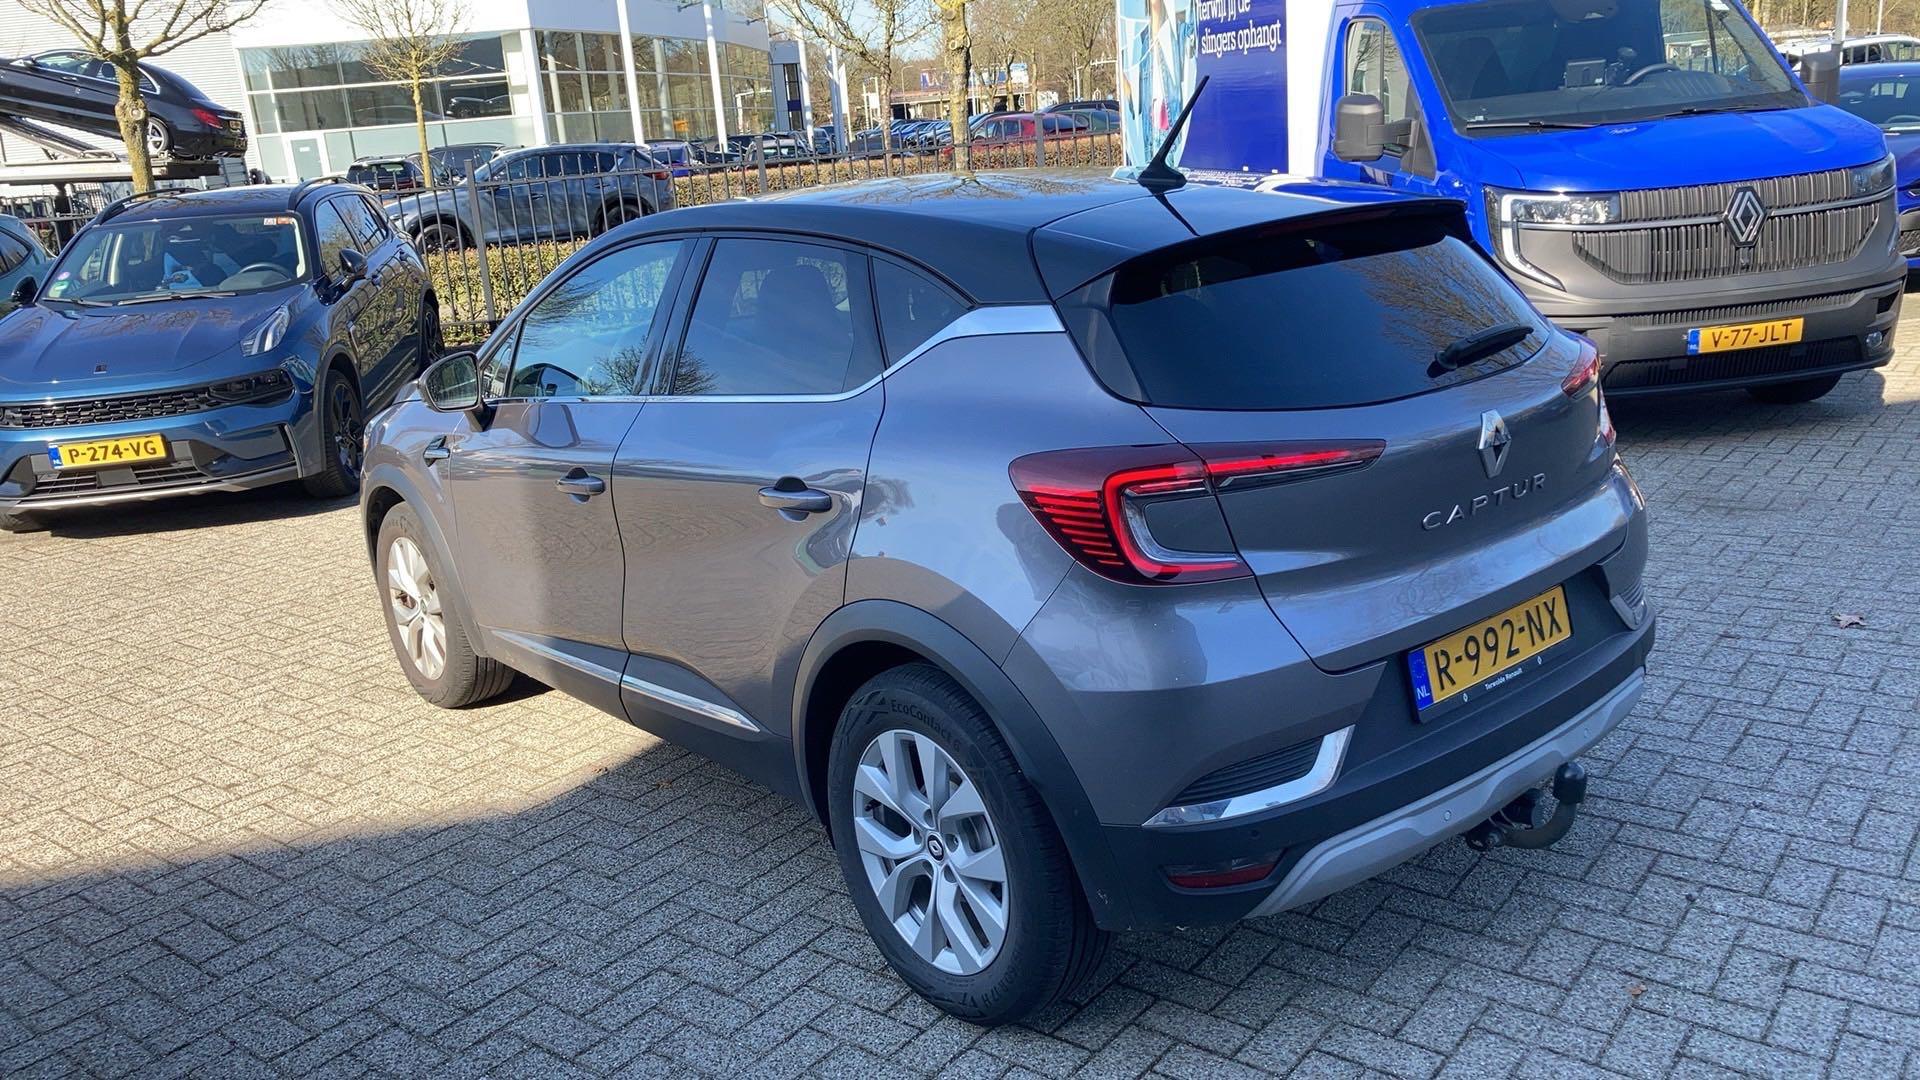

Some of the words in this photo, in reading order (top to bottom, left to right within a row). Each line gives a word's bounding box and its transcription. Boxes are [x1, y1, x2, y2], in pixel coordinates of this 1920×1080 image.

[1198, 0, 1226, 23] terwijl
[1201, 27, 1236, 58] slingers
[1238, 19, 1282, 56] ophangt
[1711, 322, 1793, 348] V-77-JLT
[67, 440, 157, 464] P-274-VG
[1422, 472, 1546, 531] CAPTUR
[1416, 684, 1431, 700] NL
[1433, 596, 1563, 692] R-992-NX
[890, 699, 952, 740] EcoContact
